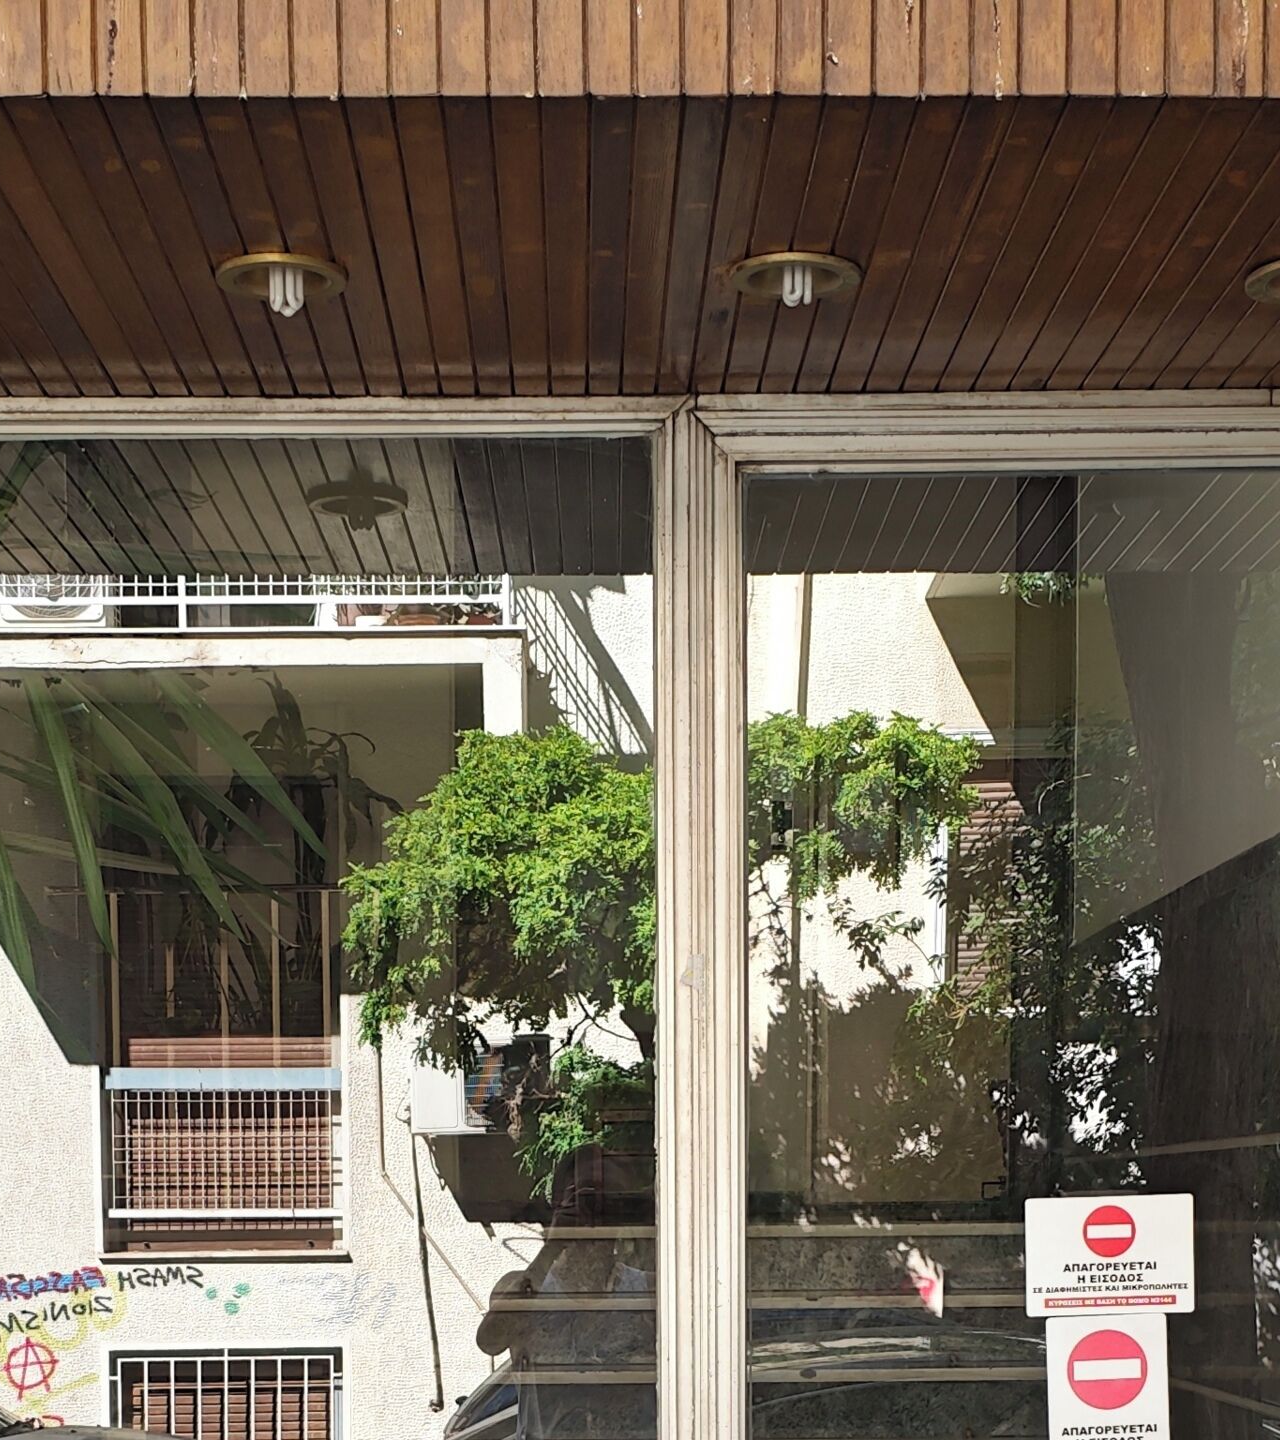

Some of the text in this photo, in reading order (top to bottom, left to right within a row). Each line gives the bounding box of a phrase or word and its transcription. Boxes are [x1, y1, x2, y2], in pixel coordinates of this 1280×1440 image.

[1063, 1262, 1157, 1272] ΑΠΑΓΟΡΕΥΕΤΑΙ
[1077, 1274, 1144, 1283] Η ΕΙΣΟΔΟΣ
[1046, 1285, 1102, 1293] ΔΙΑΦΗΜΙΣΤΕΣ
[1122, 1283, 1188, 1291] ΜΙΚΡΟΠΩΛΗΤΕΣ
[1062, 1424, 1157, 1436] ΑΠΑΓΟΡΕΥΕΤΑΙ
